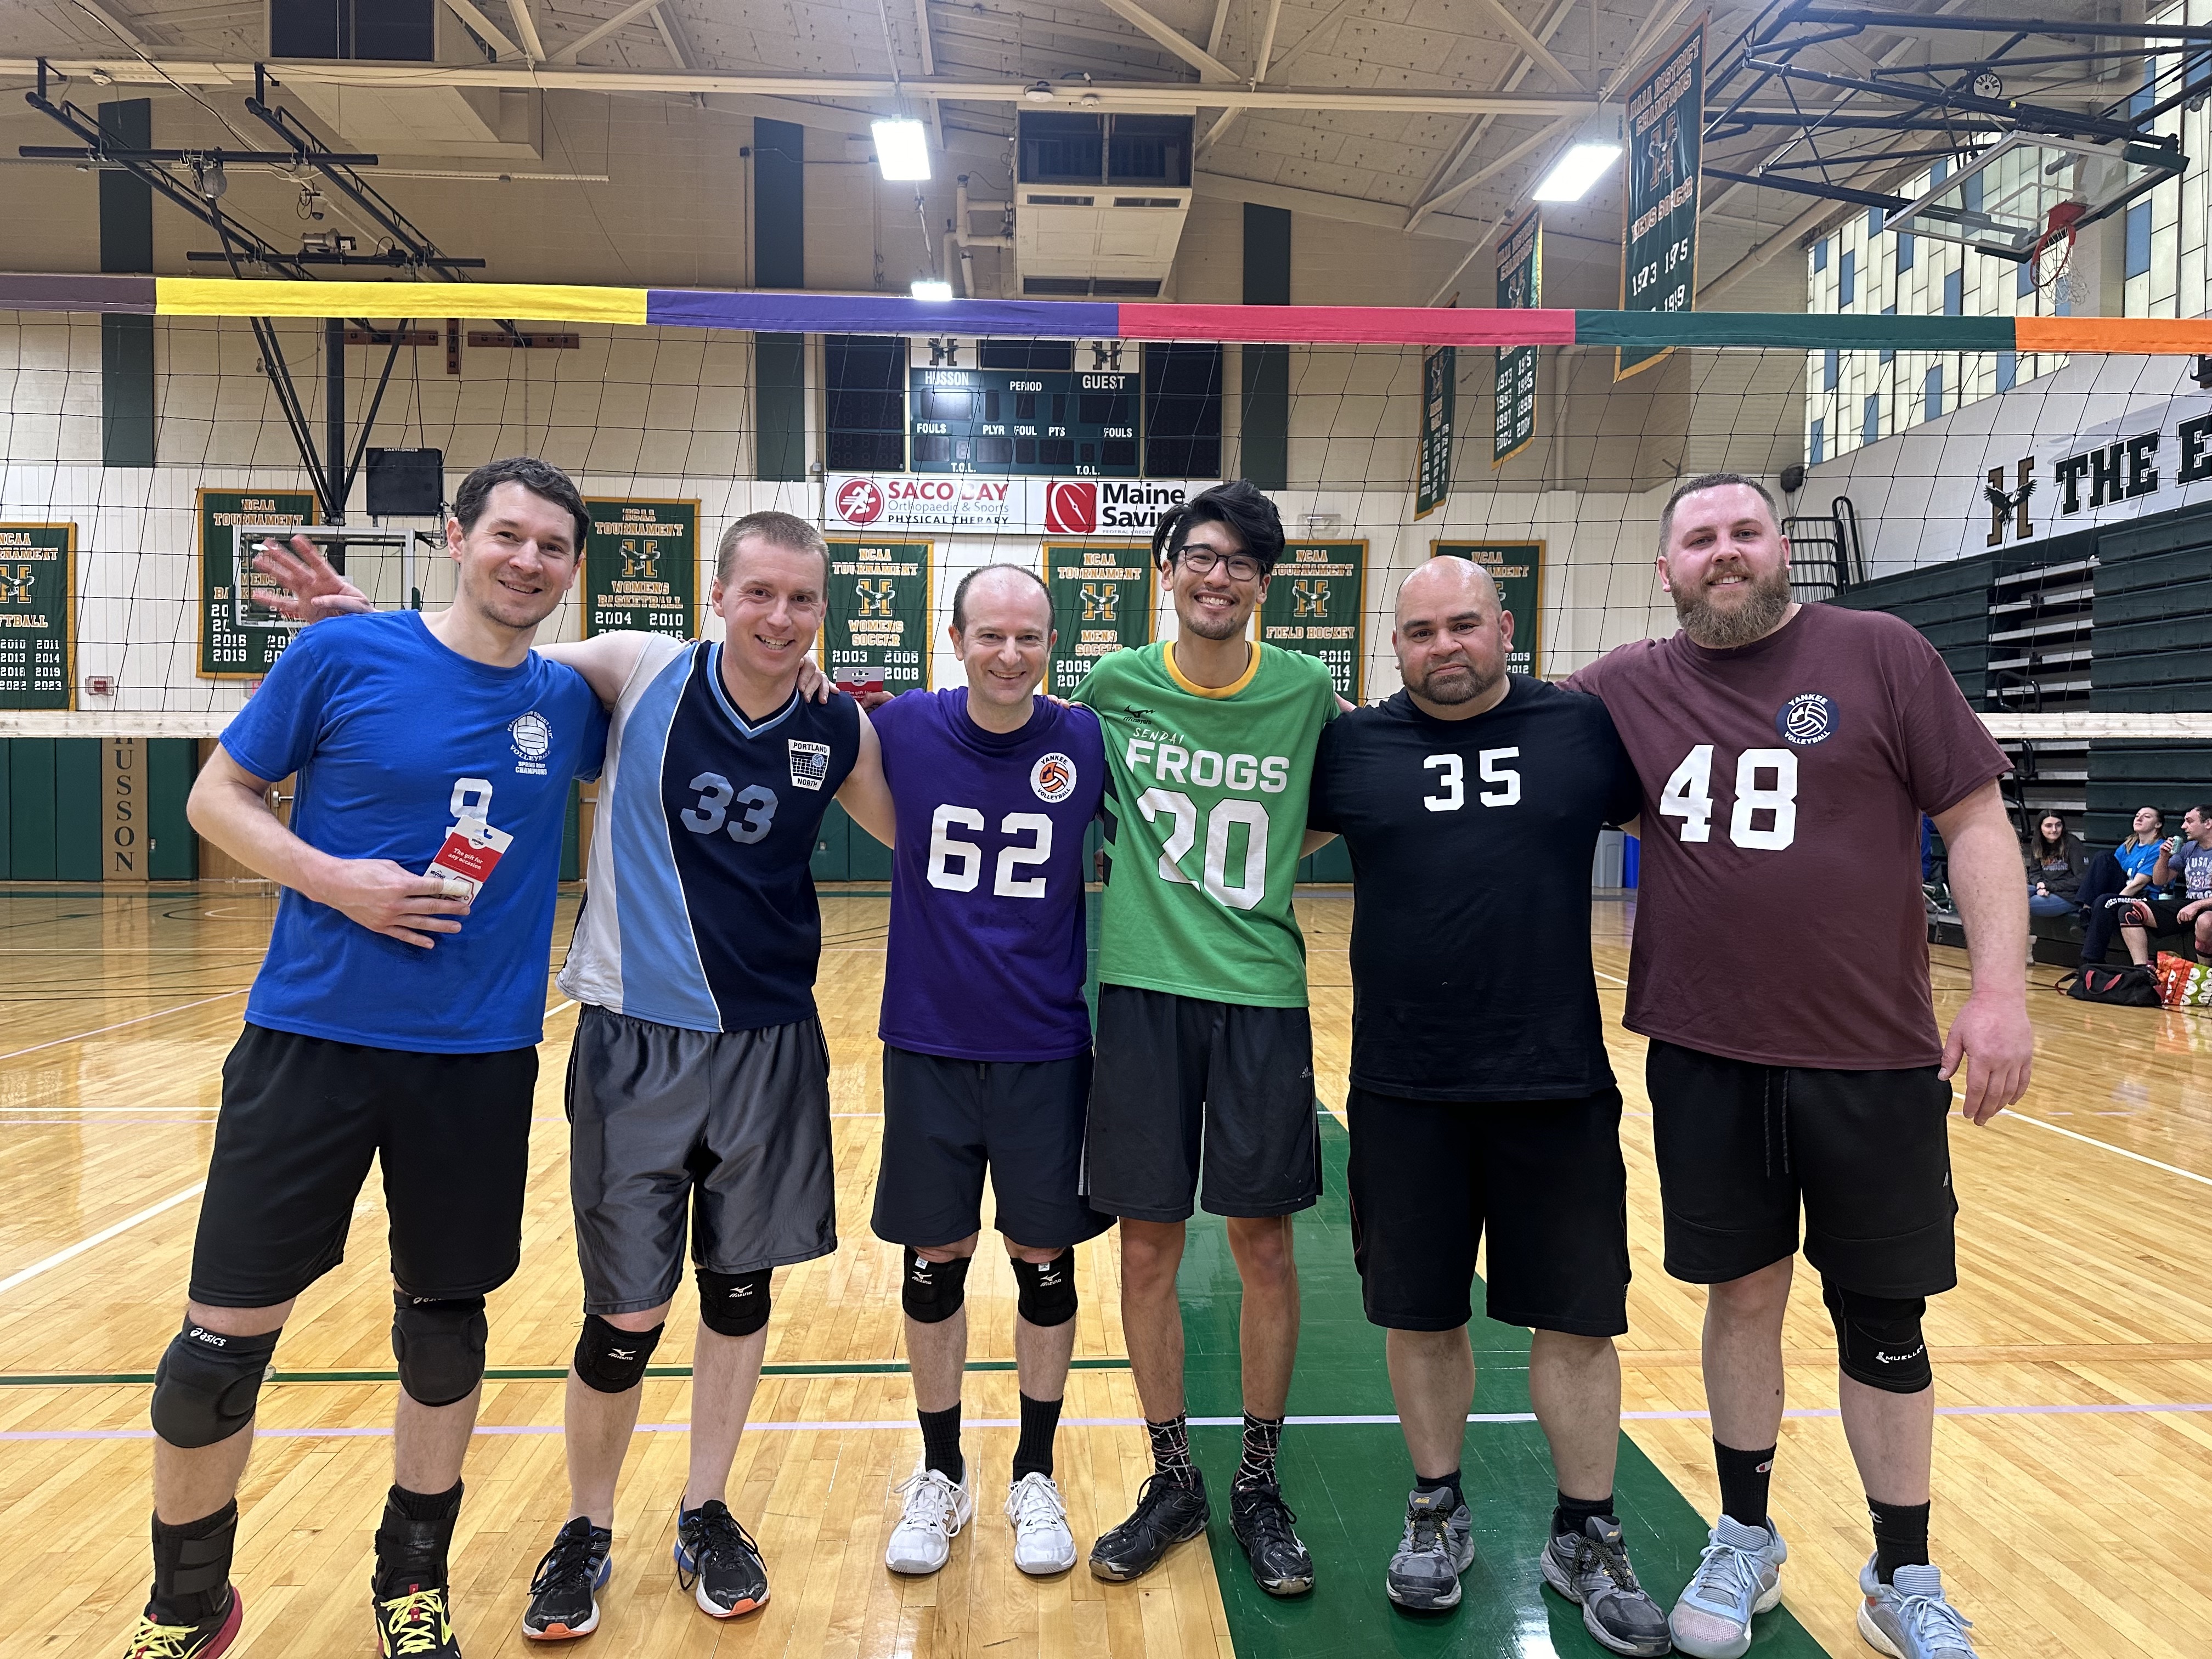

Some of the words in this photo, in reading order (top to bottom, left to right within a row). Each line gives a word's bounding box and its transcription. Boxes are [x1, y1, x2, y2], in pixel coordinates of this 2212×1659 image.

[1636, 67, 1692, 137] CHAMPIONS
[925, 371, 969, 386] HUSSON
[1082, 375, 1125, 389] GUEST
[1009, 381, 1042, 392] PERIOD
[917, 423, 946, 433] FOULS
[983, 425, 1005, 435] PLYR
[1014, 425, 1037, 436] FOUL
[1048, 426, 1065, 437] PTS
[1104, 427, 1132, 438] FOULS
[951, 462, 976, 472] T.O.L.
[1075, 465, 1100, 475] T.O.L.
[2053, 428, 2160, 518] THE
[888, 481, 953, 500] SACO
[961, 483, 1009, 500] BAY
[1103, 483, 1185, 504] Maine
[241, 499, 276, 512] NCAA
[888, 500, 957, 514] Orthopaedic
[962, 503, 970, 511] &
[974, 501, 1009, 512] Sports
[213, 513, 303, 526] TOURNAMENT
[622, 507, 656, 521] NCAA
[888, 515, 948, 523] PHYSICAL
[953, 516, 1009, 524] THERAPY
[1103, 506, 1164, 527] Savi
[595, 522, 684, 536] TOURNAMENT
[0, 548, 59, 561] NAMENT
[859, 548, 892, 561] NCAA
[1084, 553, 1116, 566] NCAA
[1296, 550, 1328, 562] NCAA
[1471, 551, 1503, 564] NCAA
[832, 562, 918, 575] TOURNAMENT
[1057, 567, 1142, 580] TOURNAMENT
[1271, 563, 1353, 576] TOURNAMENT
[240, 573, 276, 586] MENS
[612, 580, 670, 594] WOMENS
[597, 594, 683, 608] BASKETBALL
[595, 612, 631, 624] 2004
[650, 613, 683, 626] 2010
[848, 619, 904, 633] WOMENS
[1081, 630, 1117, 642] MENS
[1266, 627, 1304, 639] FIELD
[1306, 627, 1355, 639] HOCKEY
[1, 639, 26, 649] 2010
[36, 640, 59, 650] 2011
[852, 634, 900, 646] SOCCER
[213, 649, 246, 662] 2019
[832, 650, 868, 663] 2003
[1075, 644, 1123, 656] SOCCER
[1319, 650, 1351, 663] 2010
[0, 653, 26, 663] 2013
[35, 653, 60, 663] 2014
[35, 667, 60, 677] 2019
[1056, 660, 1091, 673] 2009
[1329, 664, 1350, 677] 014
[1506, 665, 1529, 674] 2012
[884, 667, 919, 680] 2008
[0, 680, 27, 690] 2022
[35, 680, 62, 690] 2023
[1057, 675, 1080, 687] 201
[1788, 693, 1828, 706] YANKEE
[1133, 727, 1184, 744] SENDAI
[1784, 731, 1831, 744] VOLLEYBALL
[510, 744, 551, 761] VOLLEYBALL
[793, 742, 827, 753] PORTLAND
[1041, 755, 1068, 765] YANKEE
[1125, 737, 1290, 793] FROGS
[515, 766, 548, 775] CHAMPIONS
[797, 777, 818, 788] NORTH
[1423, 746, 1521, 812] 35
[1037, 788, 1071, 800] VOLLEYBALL
[1659, 744, 1798, 851] 48
[680, 771, 778, 844] 33
[453, 848, 464, 856] The
[464, 852, 475, 861] gift
[927, 803, 1053, 899] 62
[1136, 786, 1270, 911] 20
[459, 857, 482, 870] occasion
[2191, 856, 2208, 867] USA
[199, 1331, 227, 1347] asics
[1885, 1344, 1924, 1361] MUELLER
